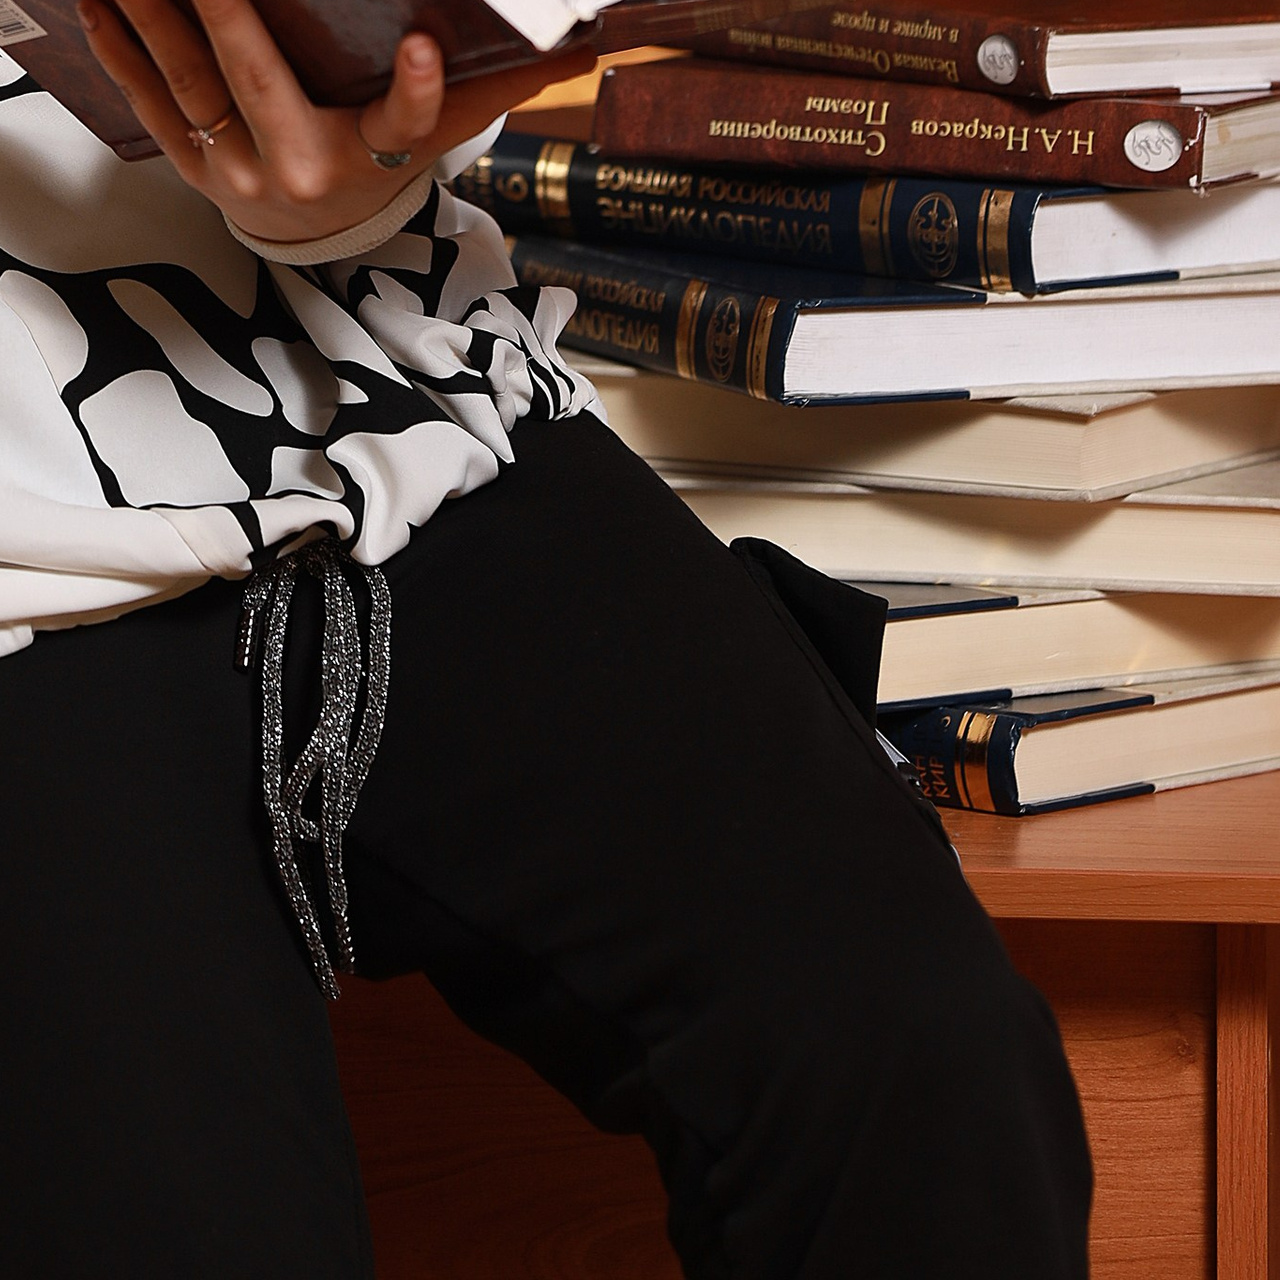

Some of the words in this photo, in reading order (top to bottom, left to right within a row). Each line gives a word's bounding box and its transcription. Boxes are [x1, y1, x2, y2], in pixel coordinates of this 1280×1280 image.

[831, 10, 877, 34] прозе
[878, 19, 890, 35] и
[891, 19, 946, 42] лирике
[774, 34, 891, 74] Отечественная
[893, 54, 960, 83] Великая
[805, 96, 890, 127] Поэмы
[708, 119, 887, 157] Стихотворения
[698, 175, 831, 213] РОССИЙСКАЯ
[596, 196, 833, 255] ЭНЦИКЛОПЕДИЯ
